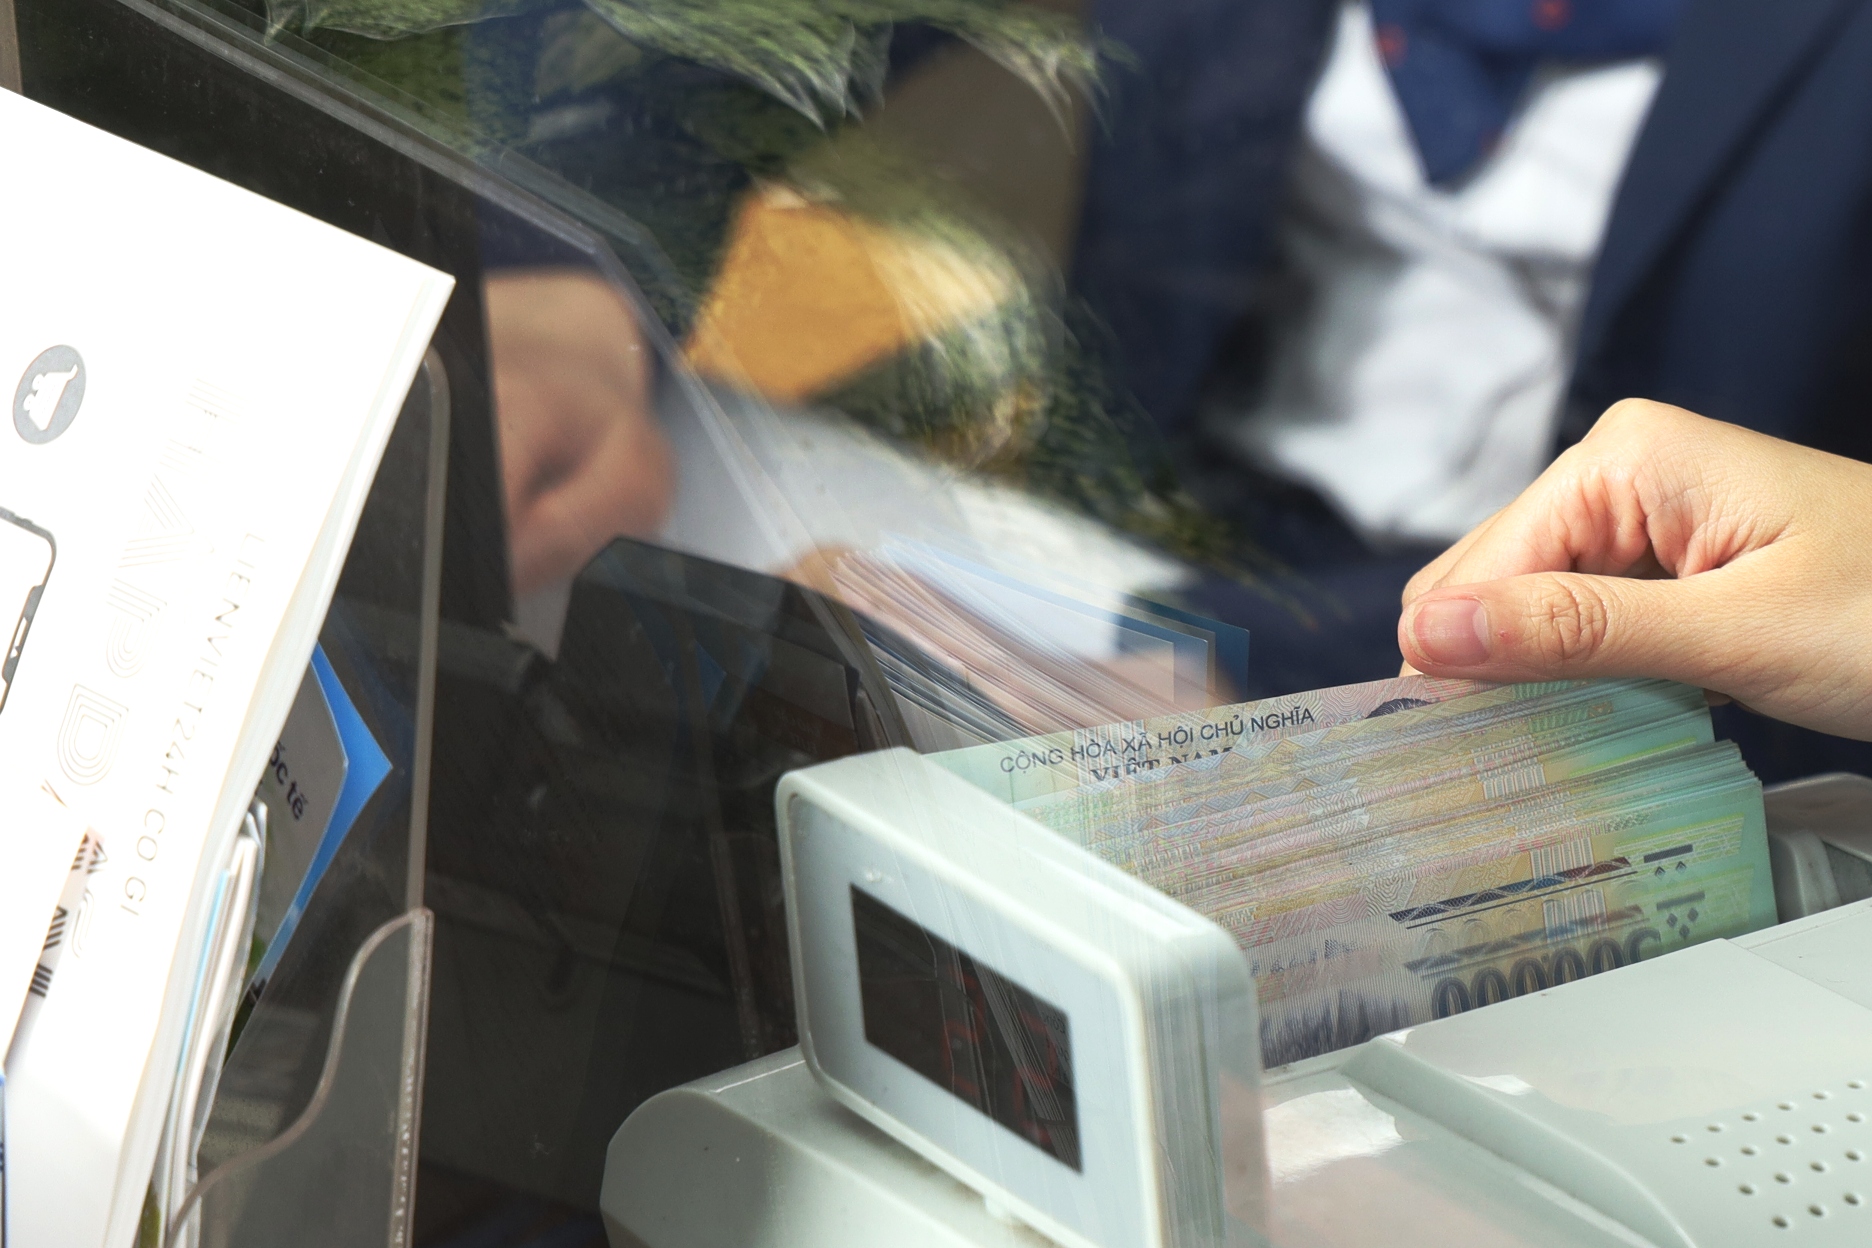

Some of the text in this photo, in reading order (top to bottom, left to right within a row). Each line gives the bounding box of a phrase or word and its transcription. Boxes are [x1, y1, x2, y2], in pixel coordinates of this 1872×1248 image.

[999, 706, 1315, 775] CỘNG HÒA XÃ HỘI CHỦ NGHĨA
